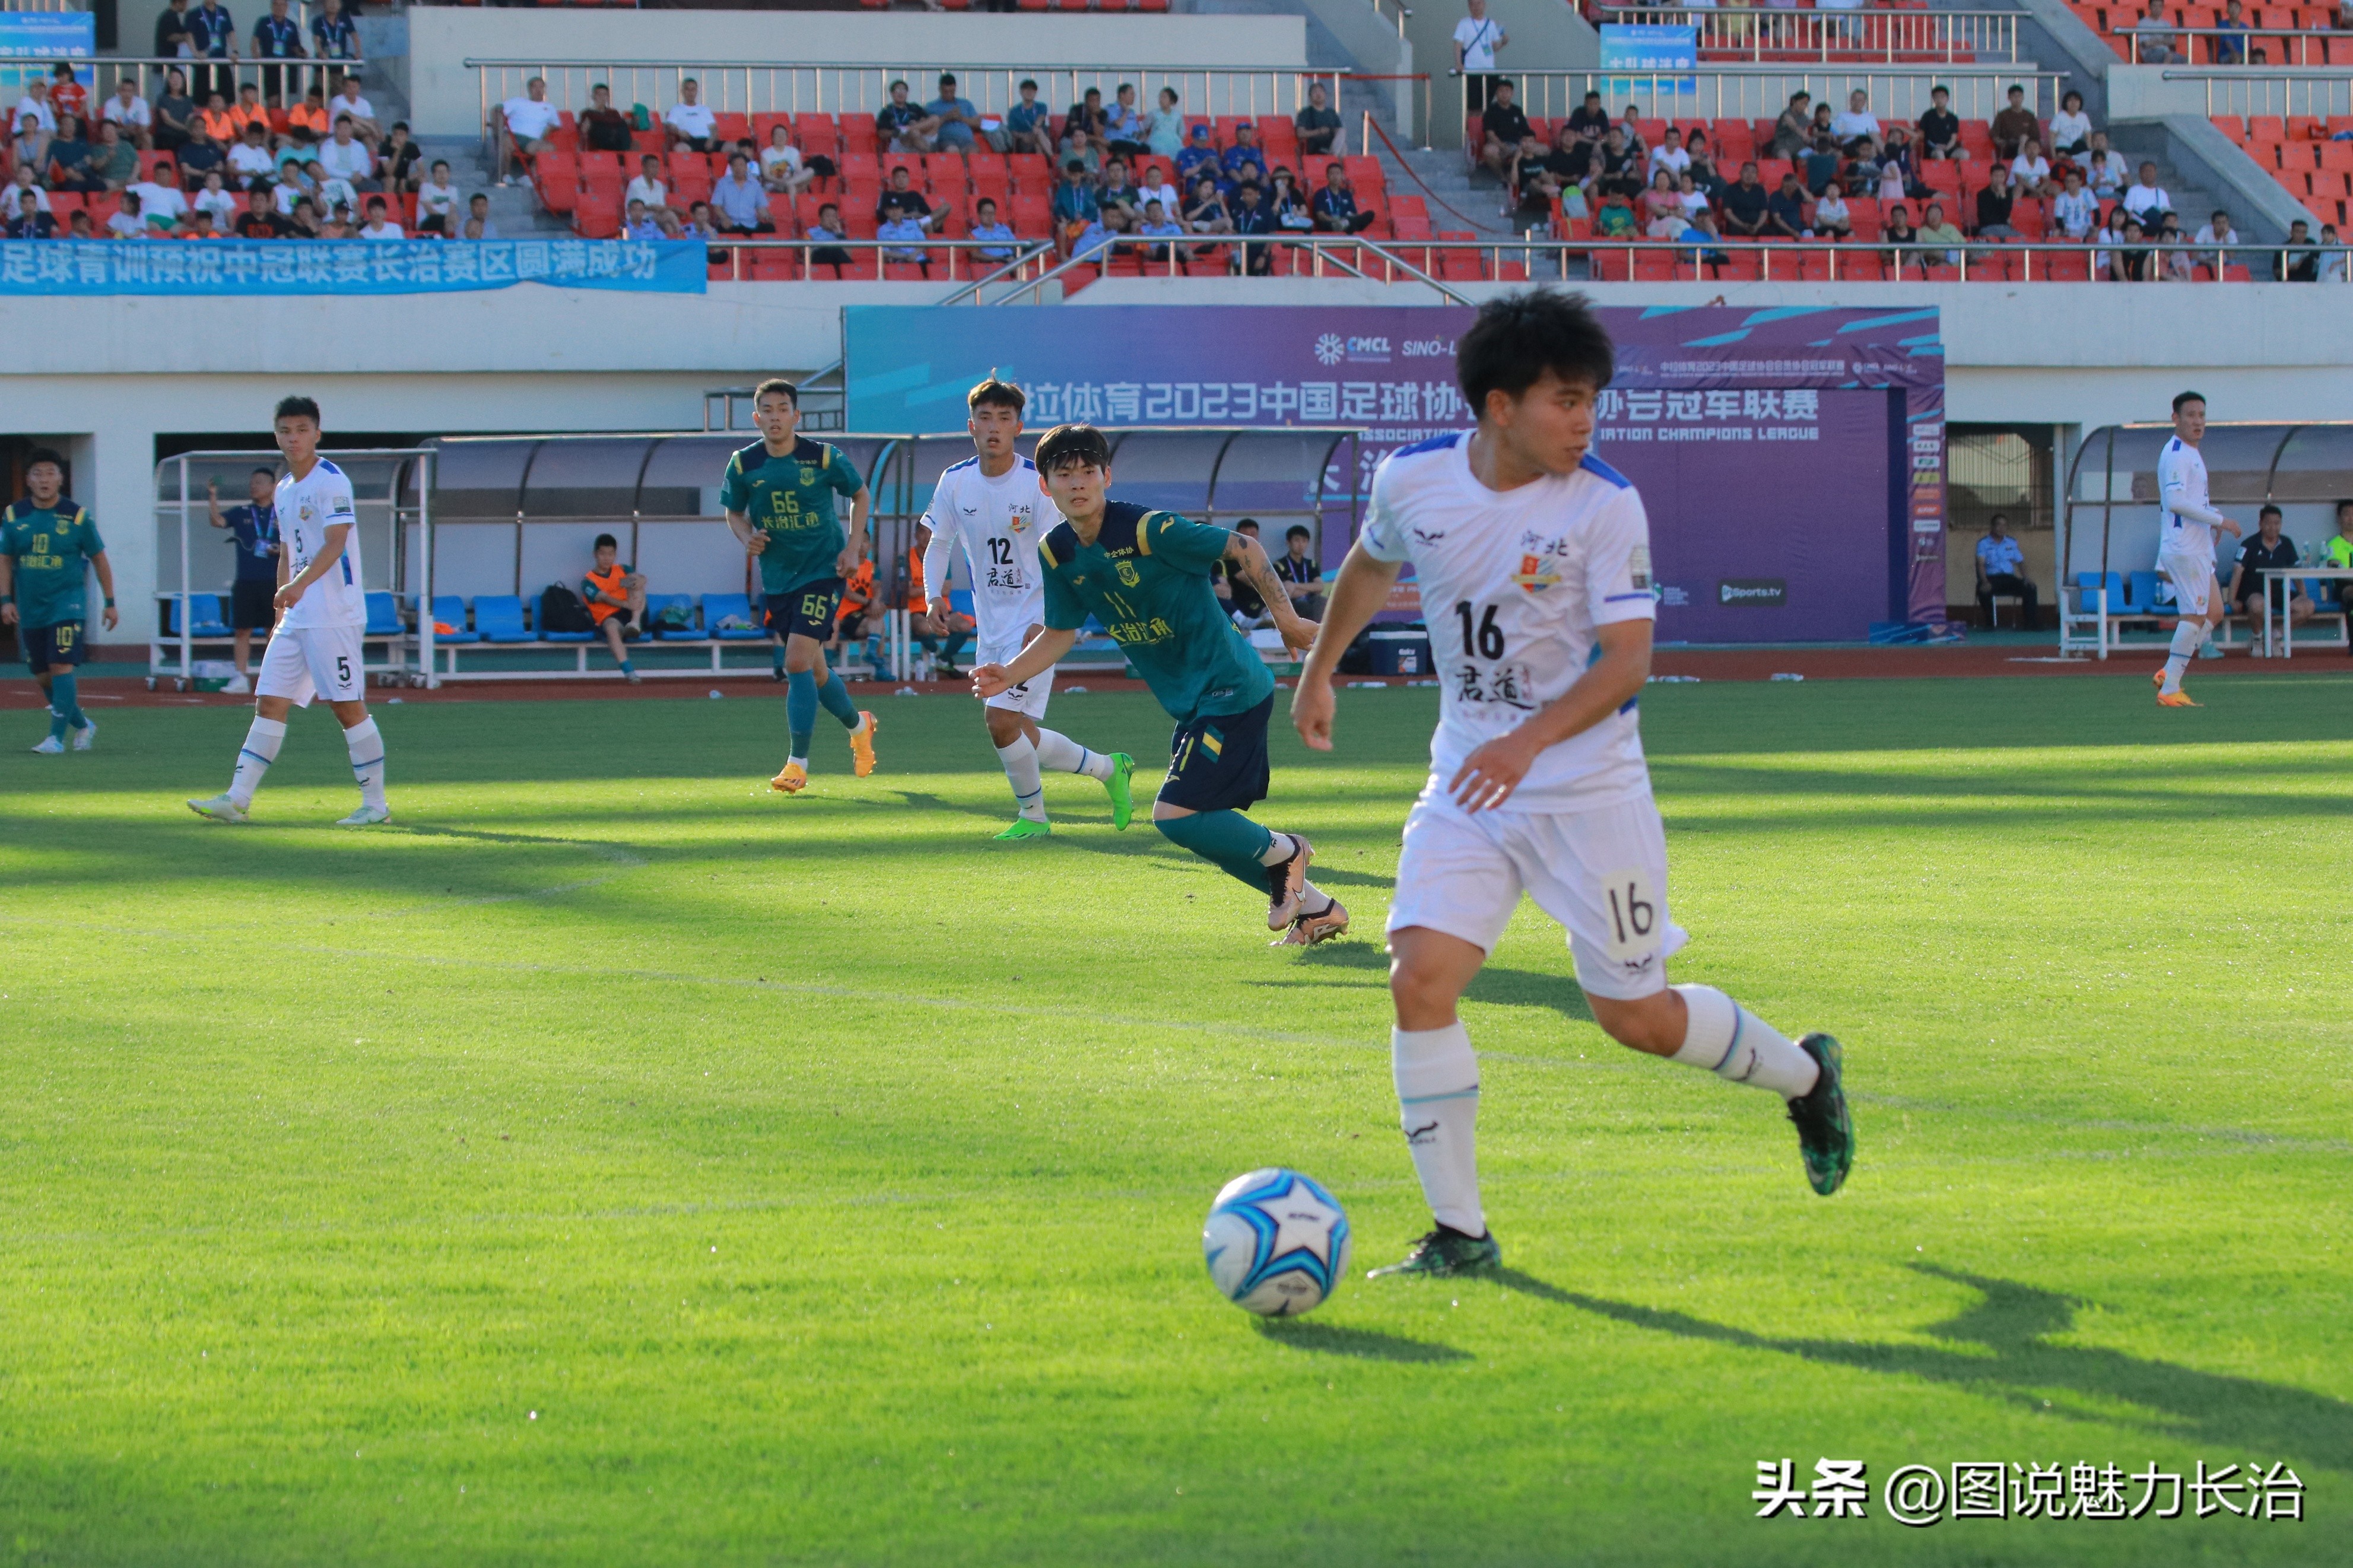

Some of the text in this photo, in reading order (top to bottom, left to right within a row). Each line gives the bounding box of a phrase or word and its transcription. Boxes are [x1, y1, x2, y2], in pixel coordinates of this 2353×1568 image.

[1347, 336, 1391, 352] CMCL
[1022, 381, 1476, 421] 拉体育2023中国足球协
[1657, 427, 1752, 441] CHAMPIONS
[1757, 427, 1819, 440] LEAGUE
[771, 491, 800, 514] 66
[1008, 504, 1030, 514] 河北
[32, 533, 49, 554] 10
[294, 529, 303, 553] 5
[987, 537, 1014, 565] 12
[1104, 546, 1134, 559] 中企体协
[801, 594, 828, 620] 66
[56, 626, 73, 647] 10
[1455, 599, 1504, 660] 16
[336, 656, 351, 682] 5
[1609, 882, 1653, 944] 16
